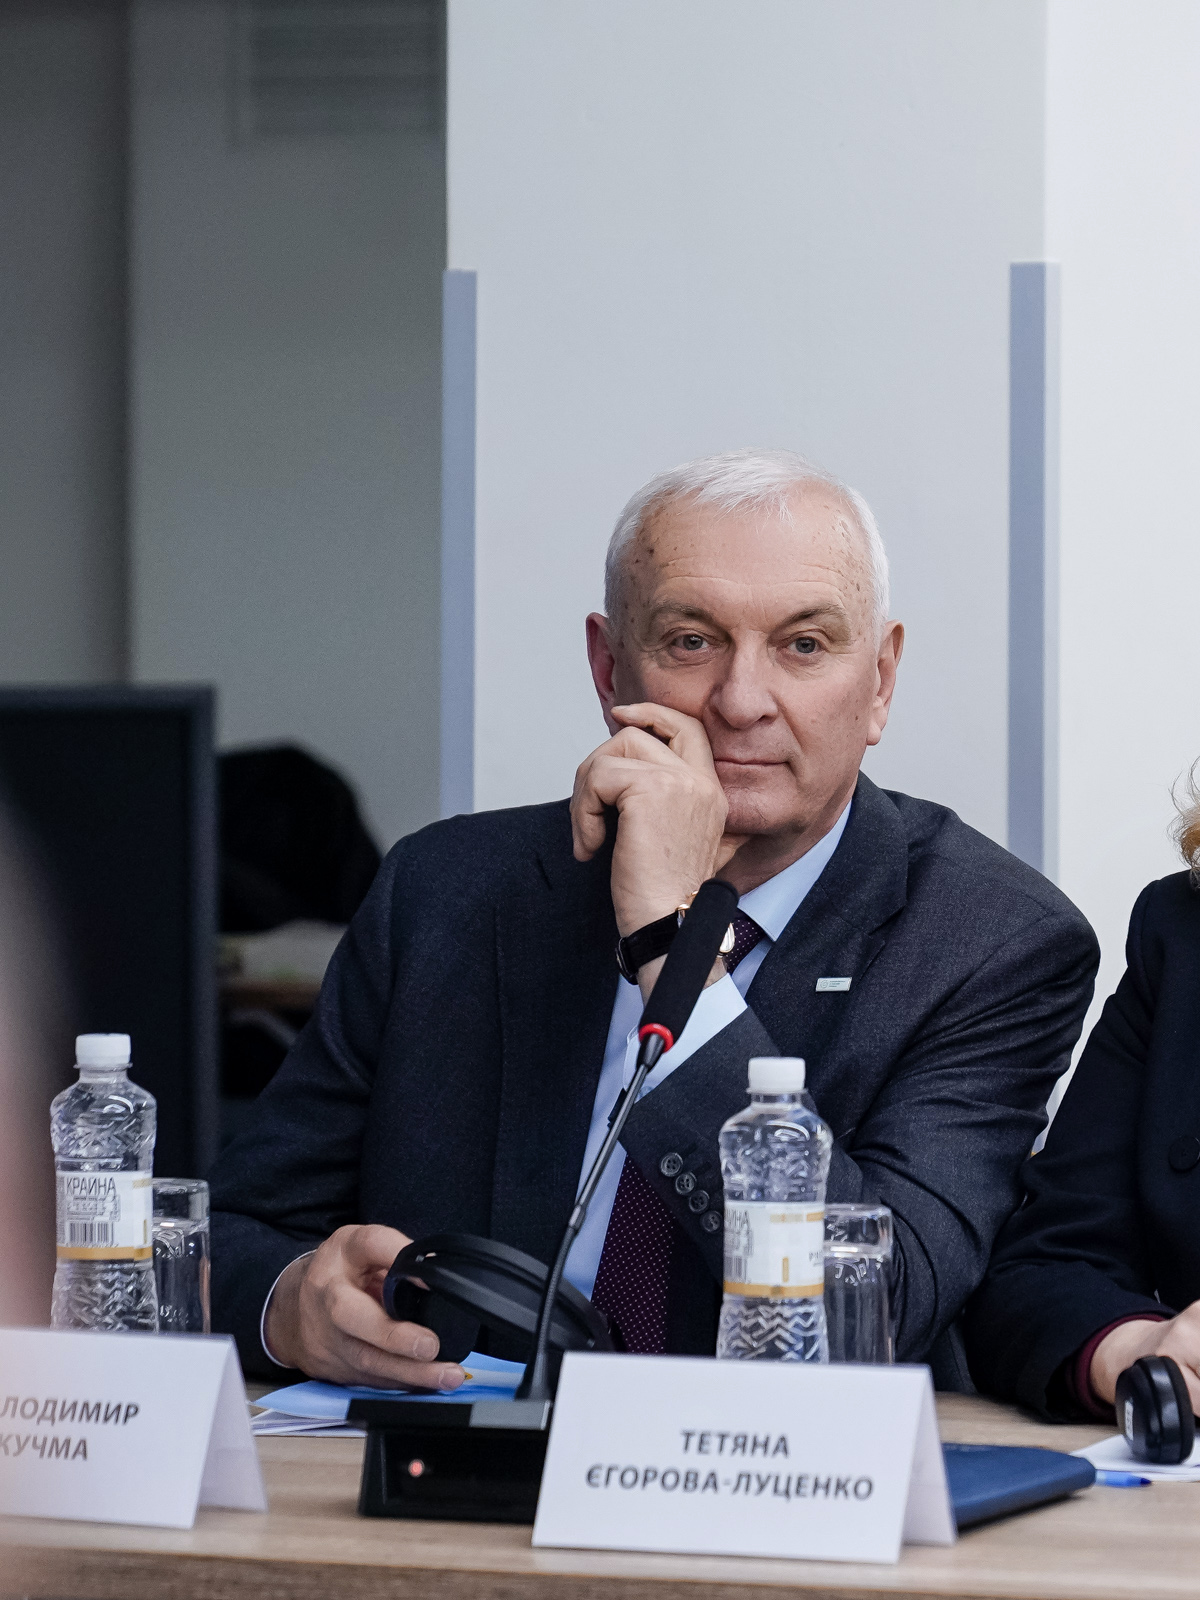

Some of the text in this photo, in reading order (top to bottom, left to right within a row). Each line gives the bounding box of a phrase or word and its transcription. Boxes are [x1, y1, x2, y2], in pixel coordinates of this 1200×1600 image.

[0, 1433, 88, 1462] КУЧМА
[680, 1429, 790, 1459] ТЕТЯНА
[585, 1463, 875, 1501] ЄГОРОВА-ЛУЦЕНКО
